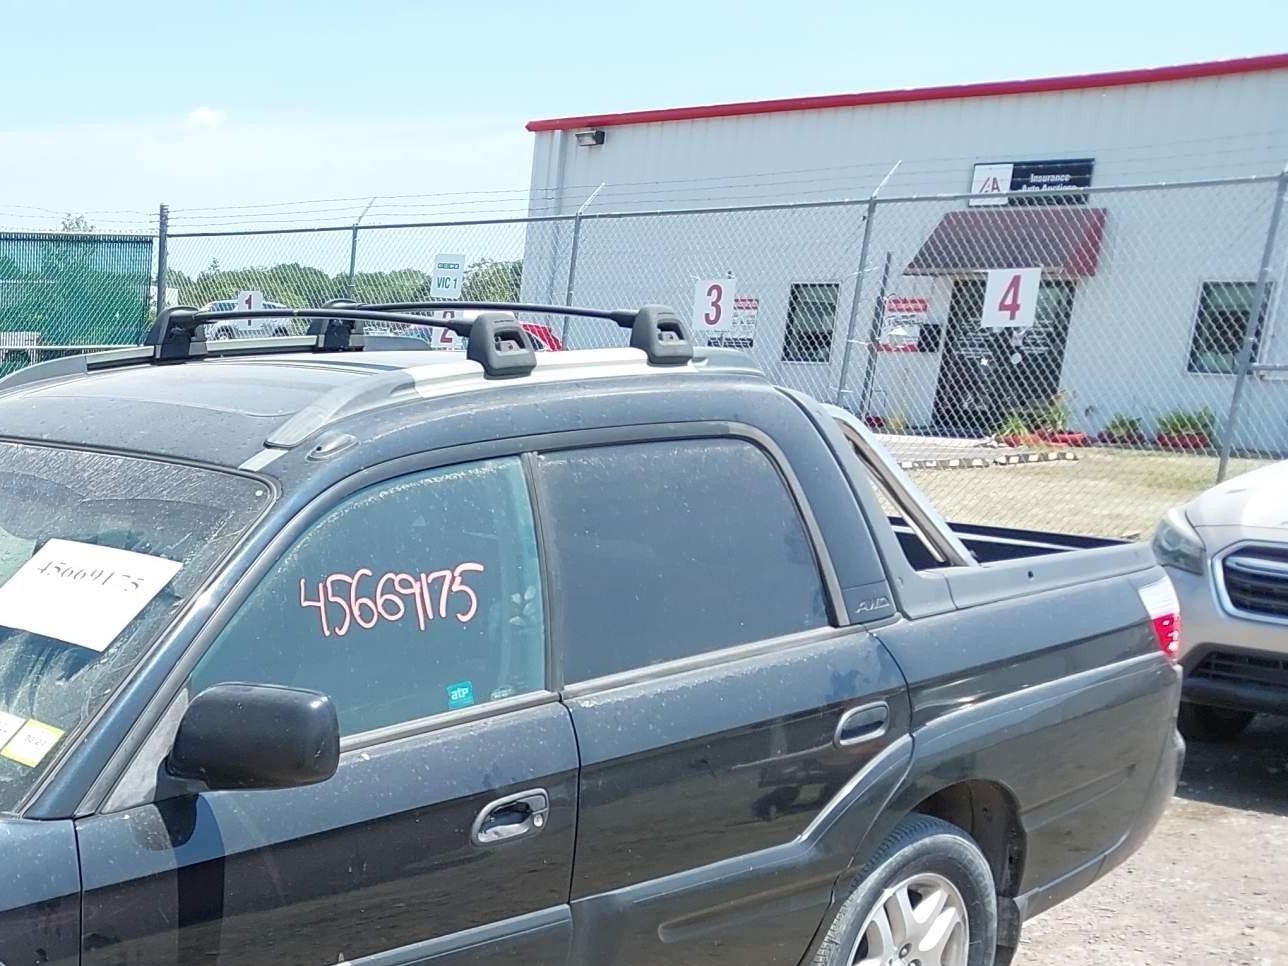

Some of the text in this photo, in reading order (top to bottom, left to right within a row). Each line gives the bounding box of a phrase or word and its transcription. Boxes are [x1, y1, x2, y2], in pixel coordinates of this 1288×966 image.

[1030, 173, 1071, 183] Insurance
[436, 276, 458, 289] VIC 1
[998, 274, 1022, 321] 4
[704, 284, 723, 326] 3
[439, 310, 456, 344] 2
[37, 559, 146, 592] 45669175
[298, 561, 486, 638] 45669175
